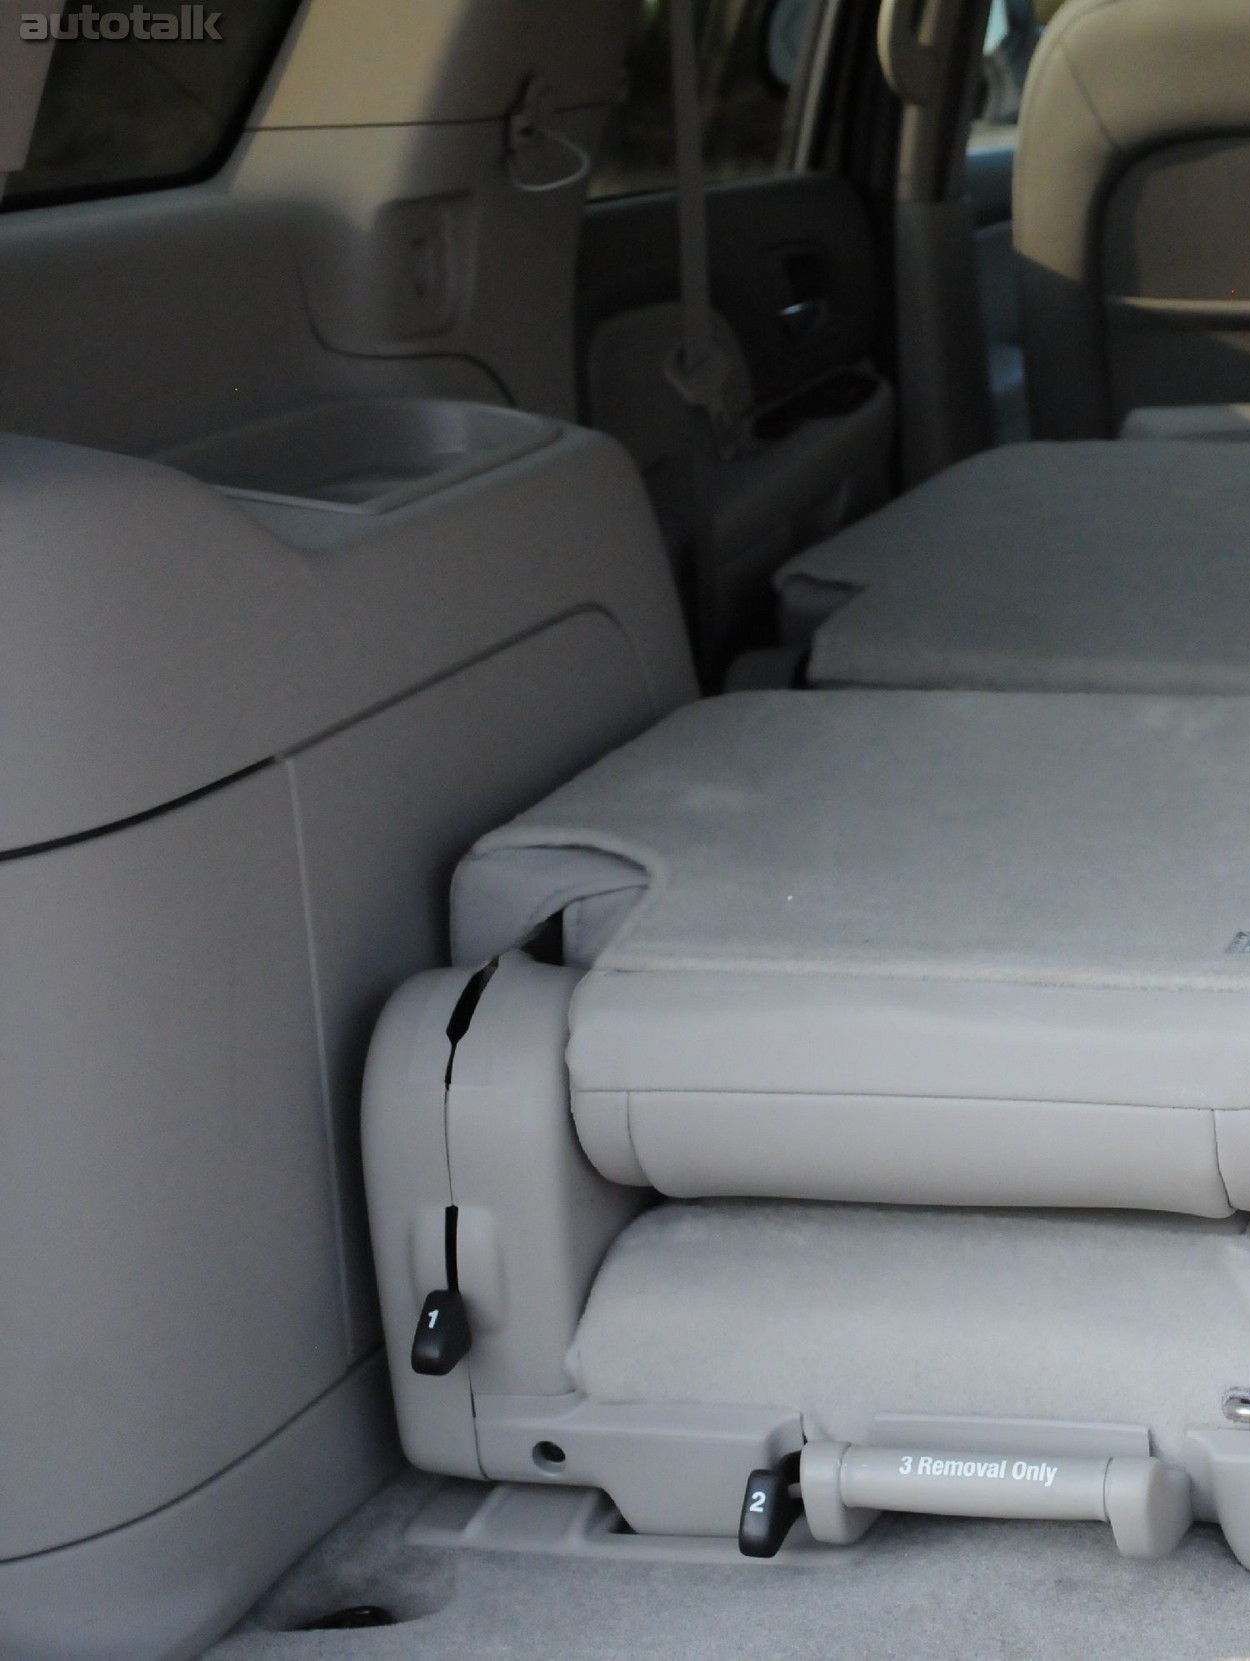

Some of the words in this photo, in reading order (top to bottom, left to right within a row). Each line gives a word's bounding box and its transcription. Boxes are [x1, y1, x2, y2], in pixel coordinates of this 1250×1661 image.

[428, 1309, 439, 1329] 1
[899, 1456, 913, 1475] 3
[917, 1456, 1007, 1479] Removal
[1011, 1461, 1058, 1487] Only
[749, 1491, 766, 1513] 2
